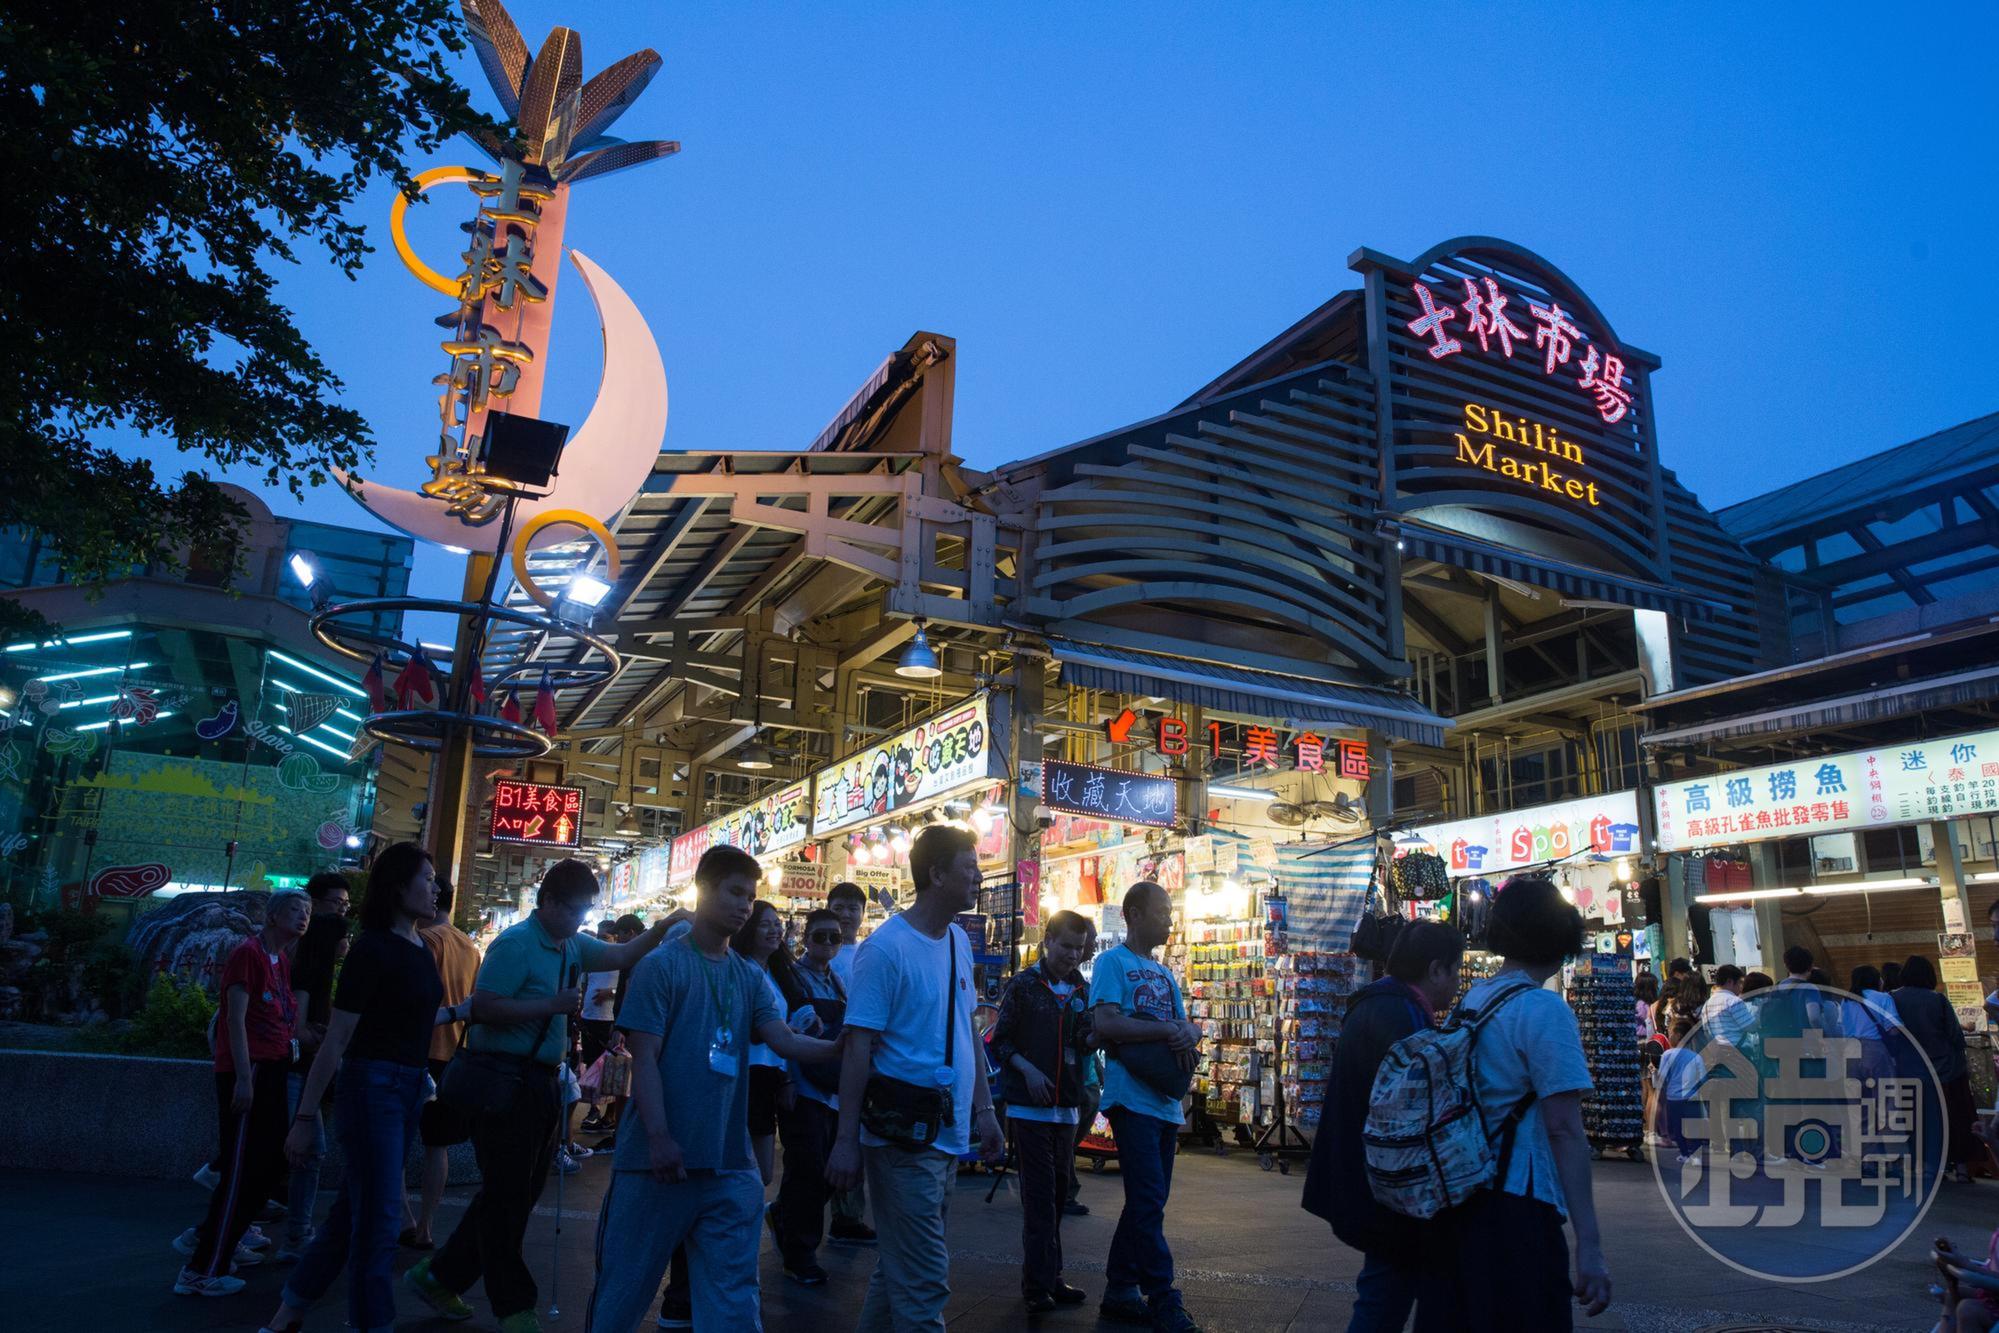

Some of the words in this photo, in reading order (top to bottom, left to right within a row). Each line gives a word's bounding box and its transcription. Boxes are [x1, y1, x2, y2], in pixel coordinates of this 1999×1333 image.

[1407, 276, 1632, 424] 士林市場
[1464, 403, 1585, 466] Shilin
[1453, 433, 1601, 507] Market
[241, 720, 294, 754] Share
[1159, 717, 1371, 781] B1美食區
[499, 786, 579, 813] B1美食區
[1051, 769, 1169, 815] 收藏天地
[1683, 763, 1848, 814] 高級撈魚
[497, 817, 523, 830] 入口
[1513, 823, 1606, 861] Sport
[1686, 800, 1850, 838] 高級孔雀魚批發零售
